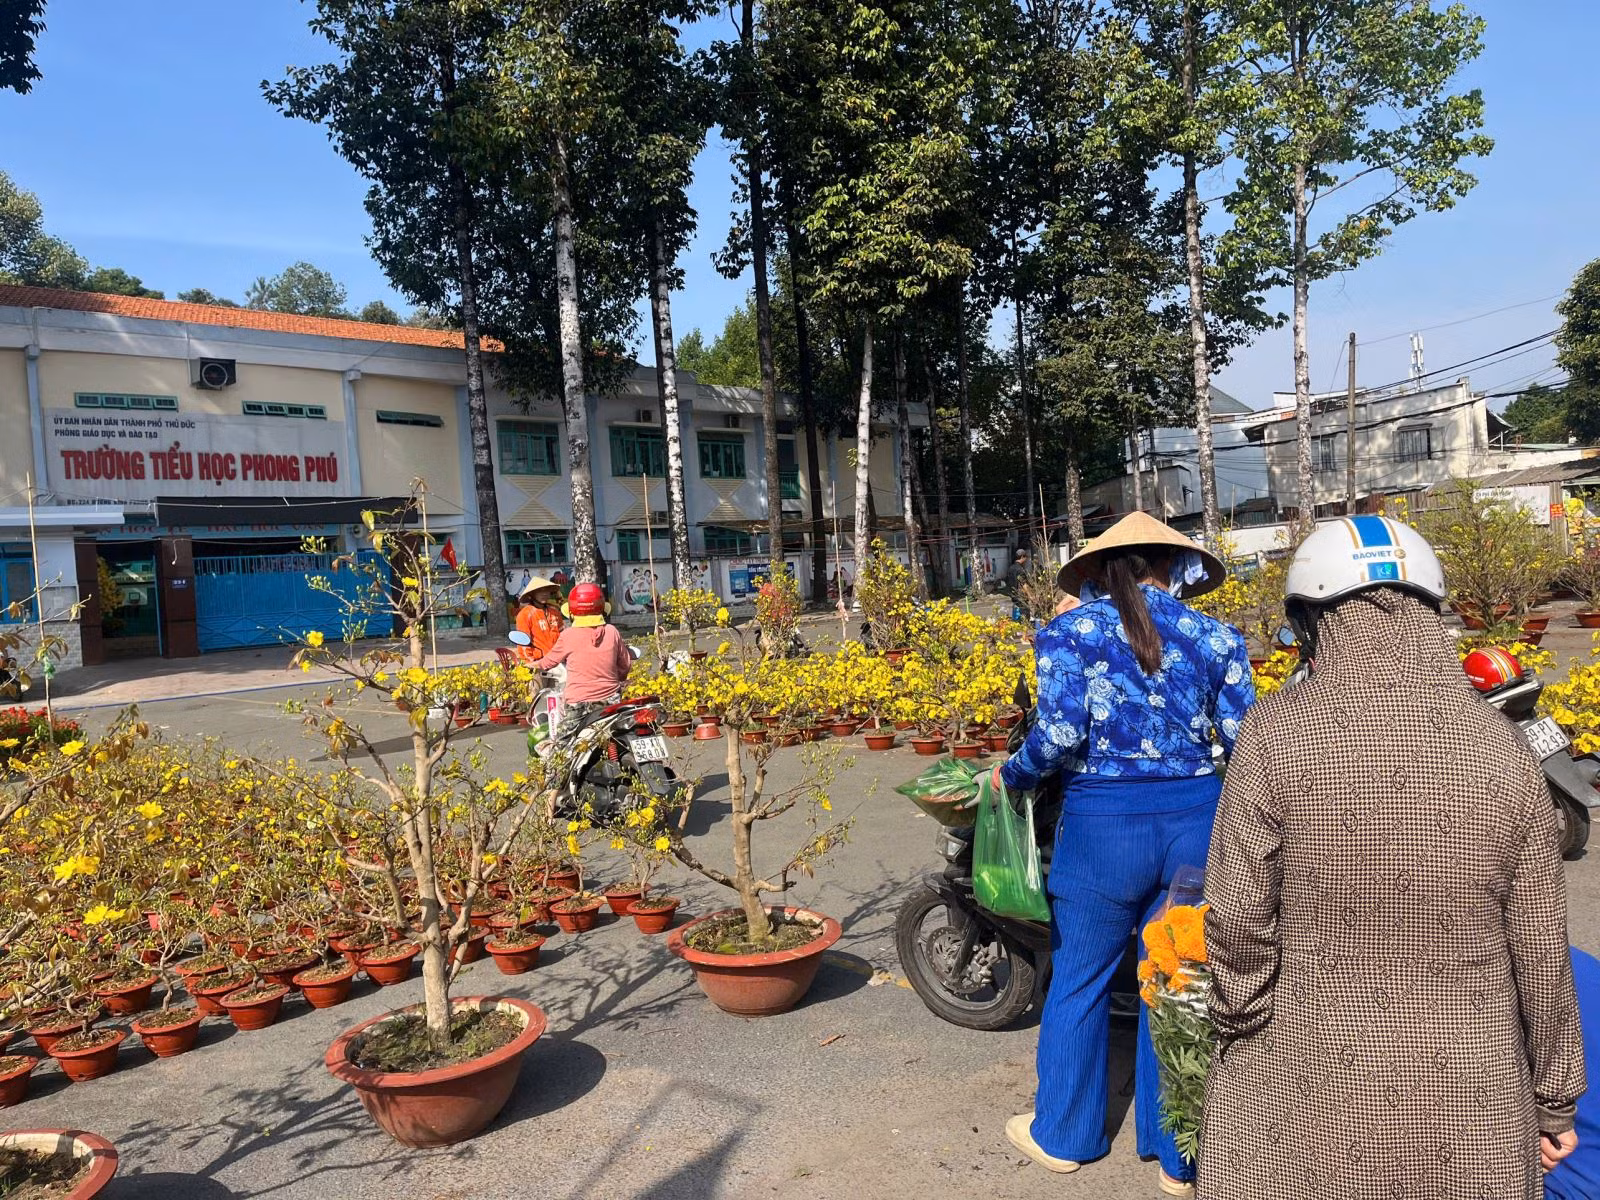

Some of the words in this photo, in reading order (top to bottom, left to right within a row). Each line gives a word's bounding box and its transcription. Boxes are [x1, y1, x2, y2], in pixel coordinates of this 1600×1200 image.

[64, 417, 80, 425] BAN
[81, 416, 102, 425] NHÂN
[103, 416, 119, 426] DÂN
[120, 418, 146, 427] THÀNH
[55, 427, 80, 437] PHÒNG
[82, 428, 99, 437] GIÁO
[60, 443, 145, 480] TRƯỜNG
[150, 441, 193, 480] TIỂU
[199, 452, 236, 486] HỌC
[241, 453, 300, 482] PHONG
[304, 452, 338, 483] PHÚ
[1352, 550, 1392, 560] BAOVIET
